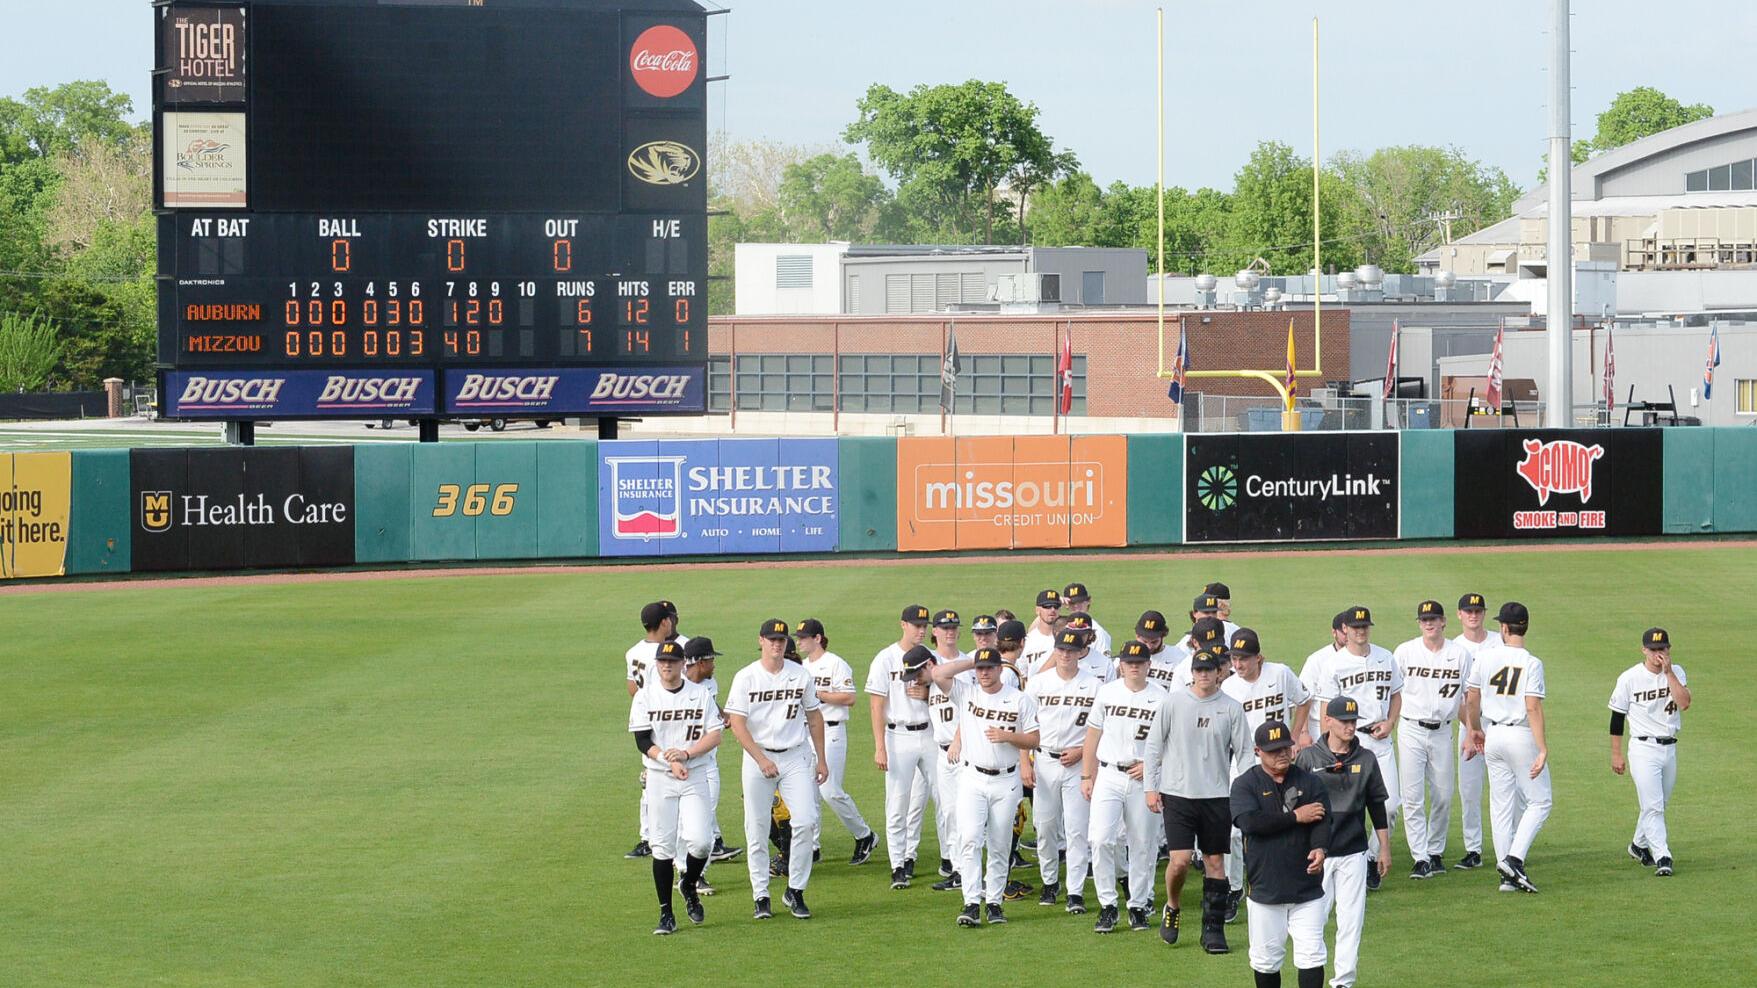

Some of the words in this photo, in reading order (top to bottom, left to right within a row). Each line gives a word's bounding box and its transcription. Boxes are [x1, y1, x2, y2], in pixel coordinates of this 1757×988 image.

[175, 23, 235, 69] TIGER
[180, 59, 234, 77] HOTEL
[633, 50, 694, 72] Coca-Cola
[177, 152, 224, 161] BOULDER
[195, 161, 233, 169] SPRINGS
[191, 219, 212, 237] AT
[217, 219, 249, 237] BAT
[319, 219, 361, 237] BALL
[427, 219, 487, 237] STRIKE
[545, 219, 578, 237] OUT
[653, 219, 681, 238] H/E
[332, 239, 350, 271] 0
[447, 239, 464, 271] 0
[554, 239, 571, 271] 0
[289, 282, 296, 297] 1
[311, 282, 320, 297] 2
[334, 282, 342, 297] 3
[365, 282, 374, 297] 4
[389, 282, 397, 297] 5
[411, 282, 420, 297] 6
[446, 282, 455, 297] 7
[468, 282, 478, 297] 8
[491, 282, 500, 297] 9
[517, 281, 536, 297] 10
[557, 281, 595, 297] RUNS
[618, 281, 649, 297] HITS
[668, 281, 695, 297] ERR
[187, 304, 260, 321] AUBURN
[286, 300, 299, 324] 0
[309, 300, 323, 324] 0
[332, 300, 346, 324] 0
[364, 300, 377, 324] 0
[387, 300, 400, 324] 3
[409, 300, 423, 324] 0
[467, 300, 480, 324] 2
[489, 300, 503, 324] 0
[578, 300, 591, 324] 6
[627, 300, 649, 324] 12
[676, 300, 689, 324] 0
[188, 335, 260, 352] MIZZOU
[286, 331, 299, 355] 0
[309, 331, 323, 355] 0
[332, 331, 346, 355] 0
[364, 331, 377, 355] 0
[387, 331, 400, 355] 0
[410, 331, 423, 355] 3
[444, 331, 458, 355] 4
[467, 331, 480, 355] 0
[579, 331, 591, 355] 7
[627, 331, 649, 355] 14
[179, 376, 285, 403] BUSCH
[318, 375, 423, 402] BUSCH
[456, 374, 560, 400] BUSCH
[590, 373, 691, 399] BUSCH
[1540, 443, 1591, 490] COMO
[619, 478, 673, 490] SHELTER
[688, 466, 834, 492] SHELTER
[1246, 473, 1381, 500] CenturyLink
[619, 490, 673, 499] INSURANCE
[925, 469, 1094, 509] missouri
[0, 485, 41, 516] oing
[432, 483, 520, 517] 366
[689, 497, 834, 516] INSURANCE
[181, 493, 274, 525] Health
[283, 494, 346, 524] Care
[994, 513, 1043, 526] CREDIT
[1047, 513, 1094, 526] UNION
[1514, 511, 1557, 529] SMOKE
[1558, 512, 1577, 527] AND
[1579, 511, 1606, 529] FIRE
[0, 518, 14, 543] it
[19, 517, 64, 543] here.
[701, 528, 729, 537] AUTO
[752, 528, 782, 536] HOME
[805, 527, 823, 535] LIFE
[1206, 598, 1215, 606] M
[1422, 603, 1432, 612] M
[1470, 596, 1480, 605] M
[918, 609, 927, 618] M
[1355, 610, 1365, 619] M
[774, 623, 784, 632] M
[1144, 620, 1156, 629] M
[1063, 634, 1076, 643] M
[1206, 630, 1215, 639] M
[1652, 632, 1663, 642] M
[662, 644, 674, 653] M
[1129, 645, 1141, 655] M
[1233, 639, 1246, 649] M
[979, 651, 990, 660] M
[1340, 671, 1392, 688] TIGERS
[1408, 667, 1460, 679] TIGERS
[1489, 666, 1523, 696] 41
[749, 689, 804, 703] TIGERS
[1439, 684, 1460, 698] 47
[1634, 687, 1671, 702] TIGE
[1038, 695, 1095, 707] TIGERS
[1243, 693, 1284, 713] GERS
[1346, 701, 1356, 712] M
[648, 709, 703, 722] TIGERS
[939, 707, 953, 722] 10
[968, 701, 1018, 722] TIGERS
[1075, 711, 1089, 726] 8
[1197, 717, 1210, 728] M
[1135, 725, 1150, 740] 5
[1268, 727, 1281, 741] M
[1351, 764, 1361, 773] M
